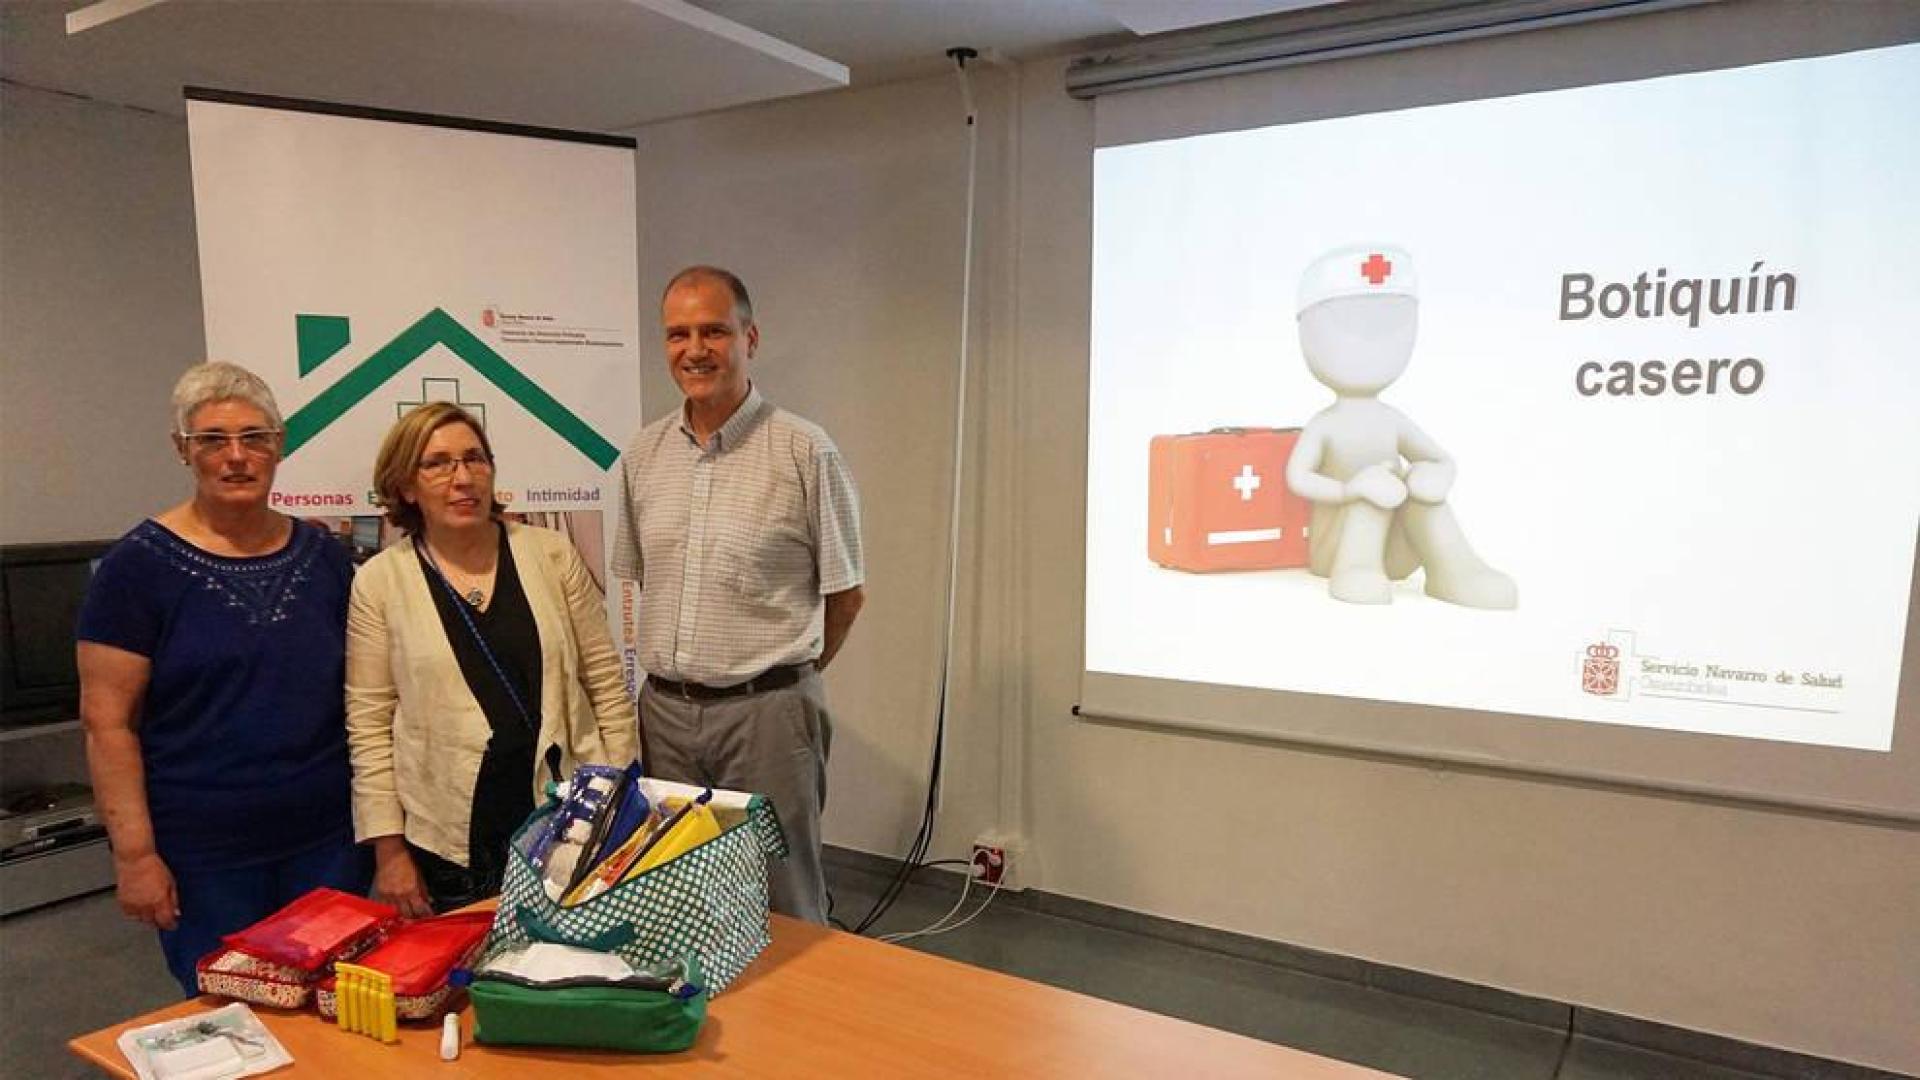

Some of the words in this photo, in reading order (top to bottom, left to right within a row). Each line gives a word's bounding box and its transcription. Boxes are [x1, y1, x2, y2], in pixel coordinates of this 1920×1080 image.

[1559, 260, 1797, 328] Botiquín
[1575, 357, 1765, 397] casero
[271, 491, 354, 507] Personas
[526, 487, 600, 501] Intimidad
[1641, 660, 1699, 677] Servicio
[1706, 664, 1767, 683] Navarro
[1775, 669, 1794, 685] de
[1801, 673, 1843, 688] Salud
